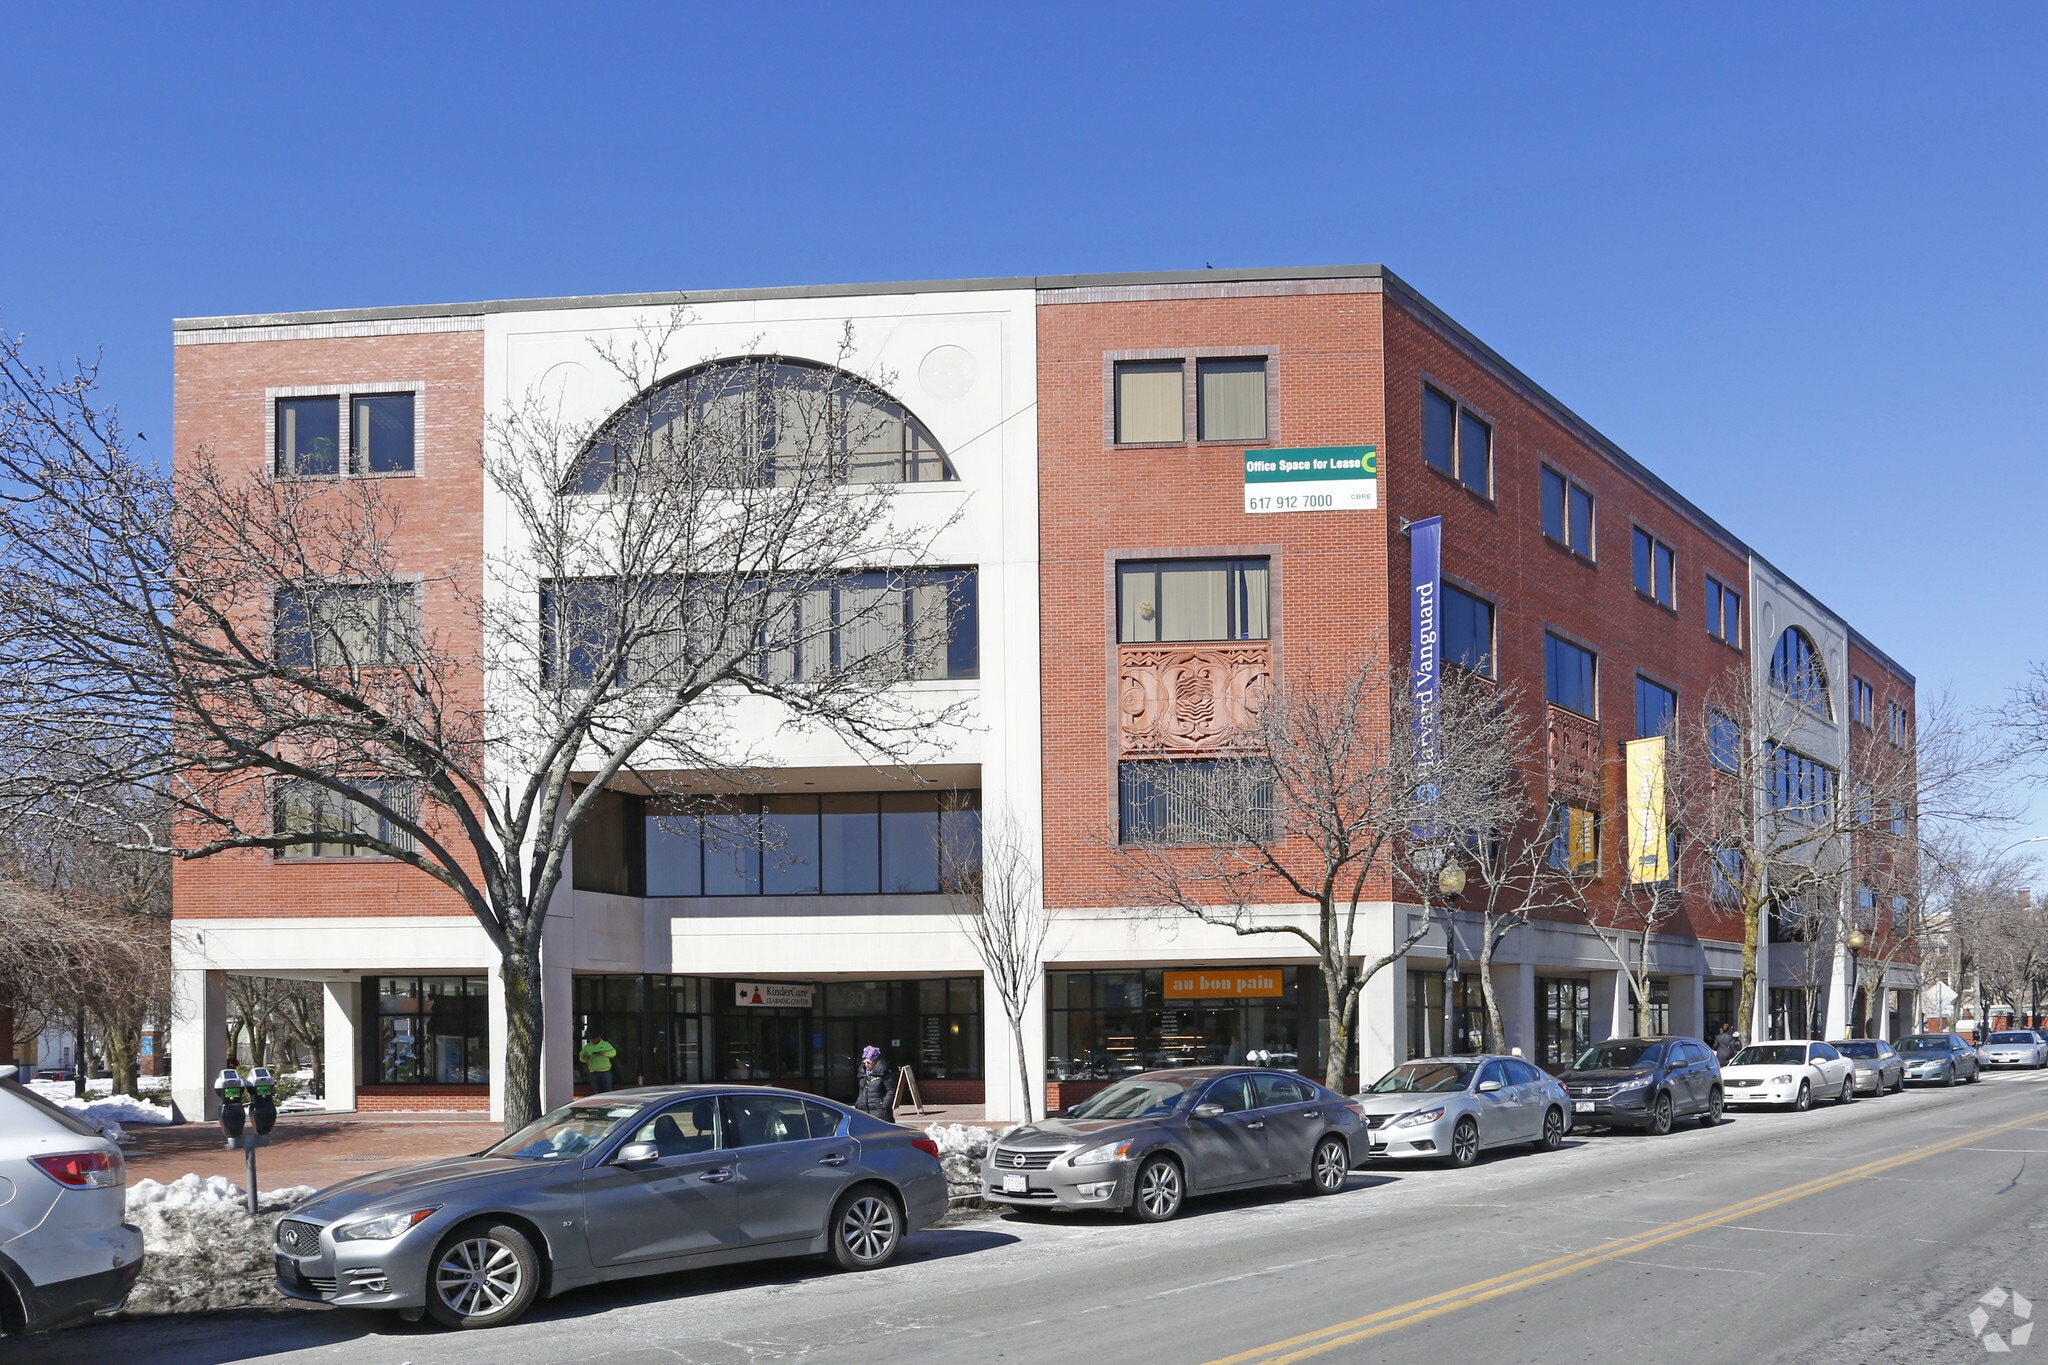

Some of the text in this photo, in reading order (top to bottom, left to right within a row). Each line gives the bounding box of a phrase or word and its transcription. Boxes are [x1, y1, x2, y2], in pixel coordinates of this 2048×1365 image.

[1246, 461, 1276, 472] Office
[1279, 460, 1310, 472] Space
[1313, 458, 1328, 470] for
[1330, 458, 1361, 469] Lease
[1250, 494, 1332, 510] 617 912 7000
[1416, 580, 1437, 687] Vanguard
[766, 986, 808, 997] KinderCare
[1173, 975, 1273, 993] au bon pain
